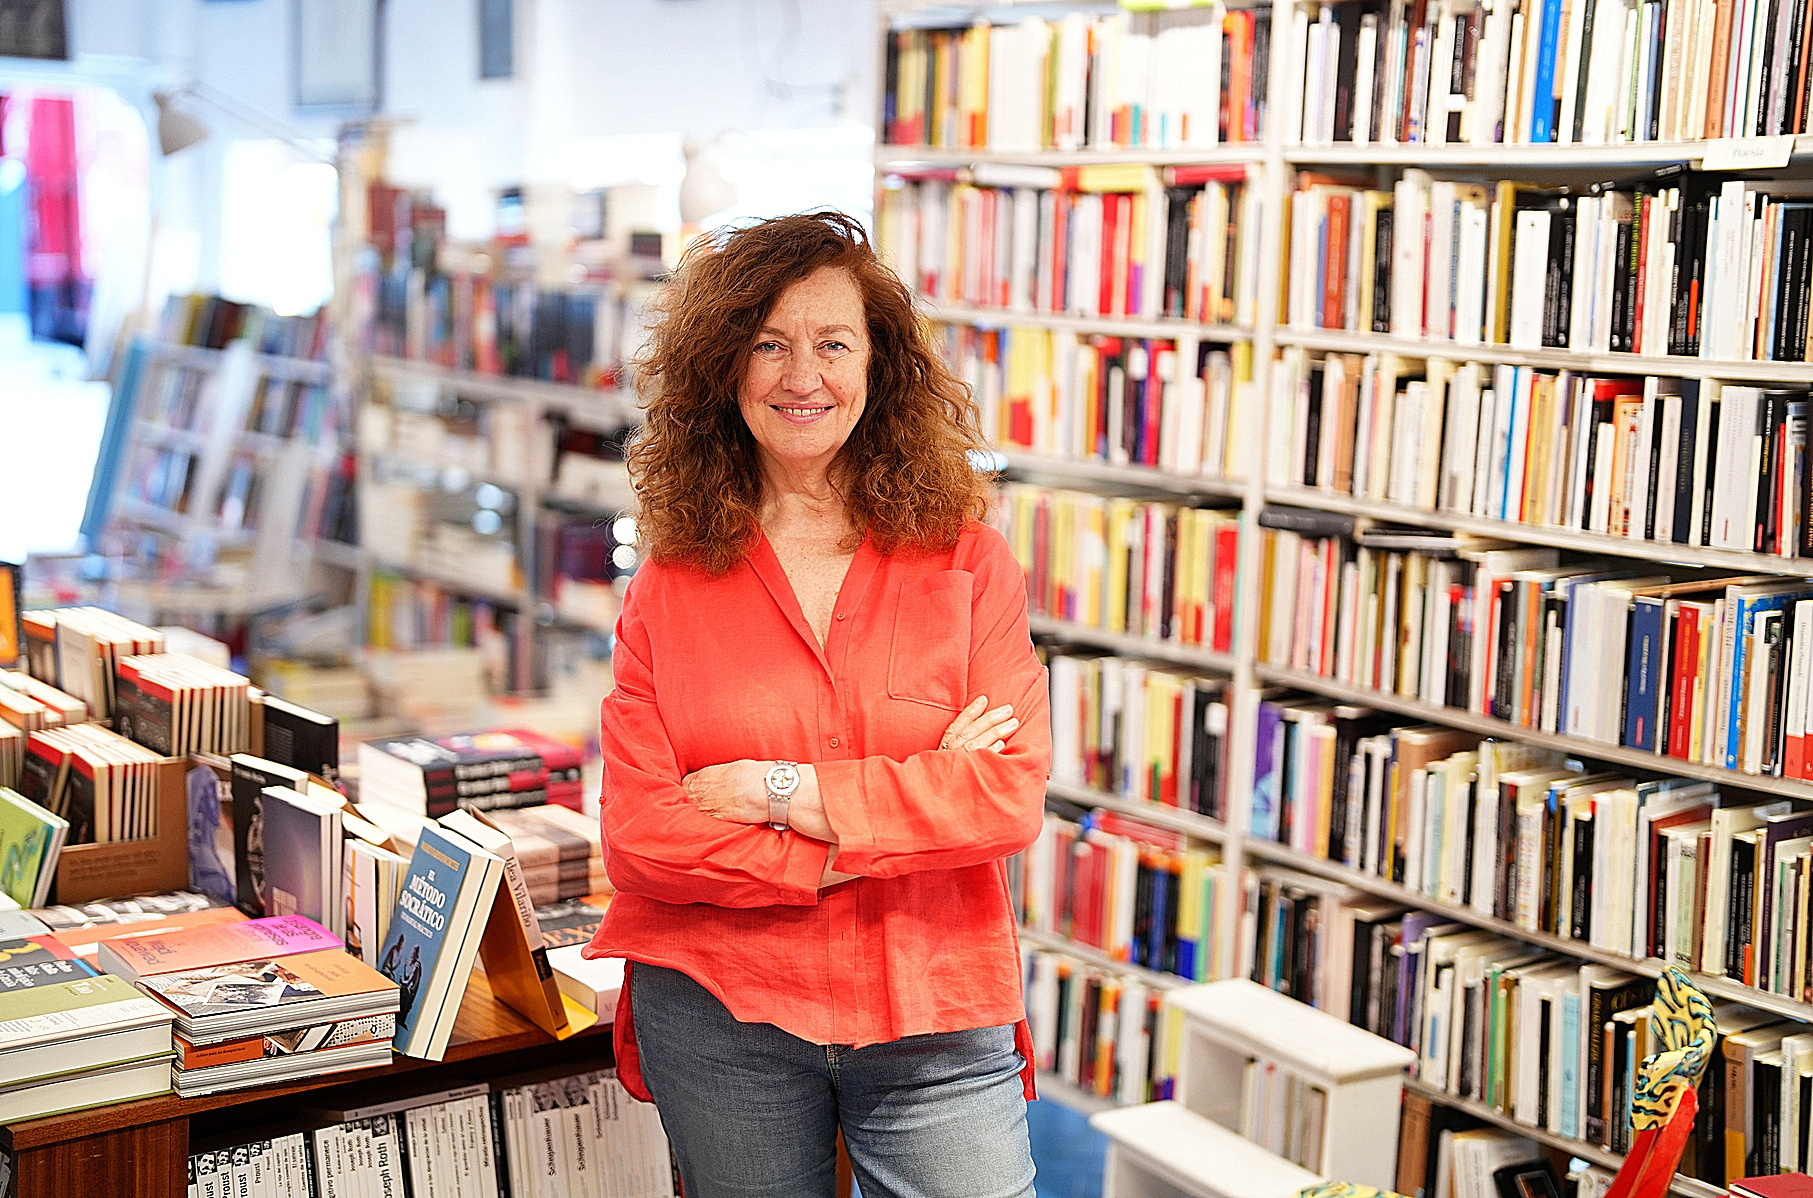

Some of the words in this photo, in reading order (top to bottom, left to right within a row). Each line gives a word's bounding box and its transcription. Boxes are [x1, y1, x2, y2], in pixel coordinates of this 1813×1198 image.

[409, 875, 447, 909] MÉTODO
[505, 856, 518, 882] Idea
[512, 880, 532, 928] Vilariño
[399, 889, 445, 932] SOCRÁTICO
[323, 1139, 334, 1178] permanece
[377, 1142, 388, 1167] Roth
[238, 1173, 248, 1197] roust
[254, 1162, 262, 1184] Proust
[380, 1169, 393, 1198] oseph
